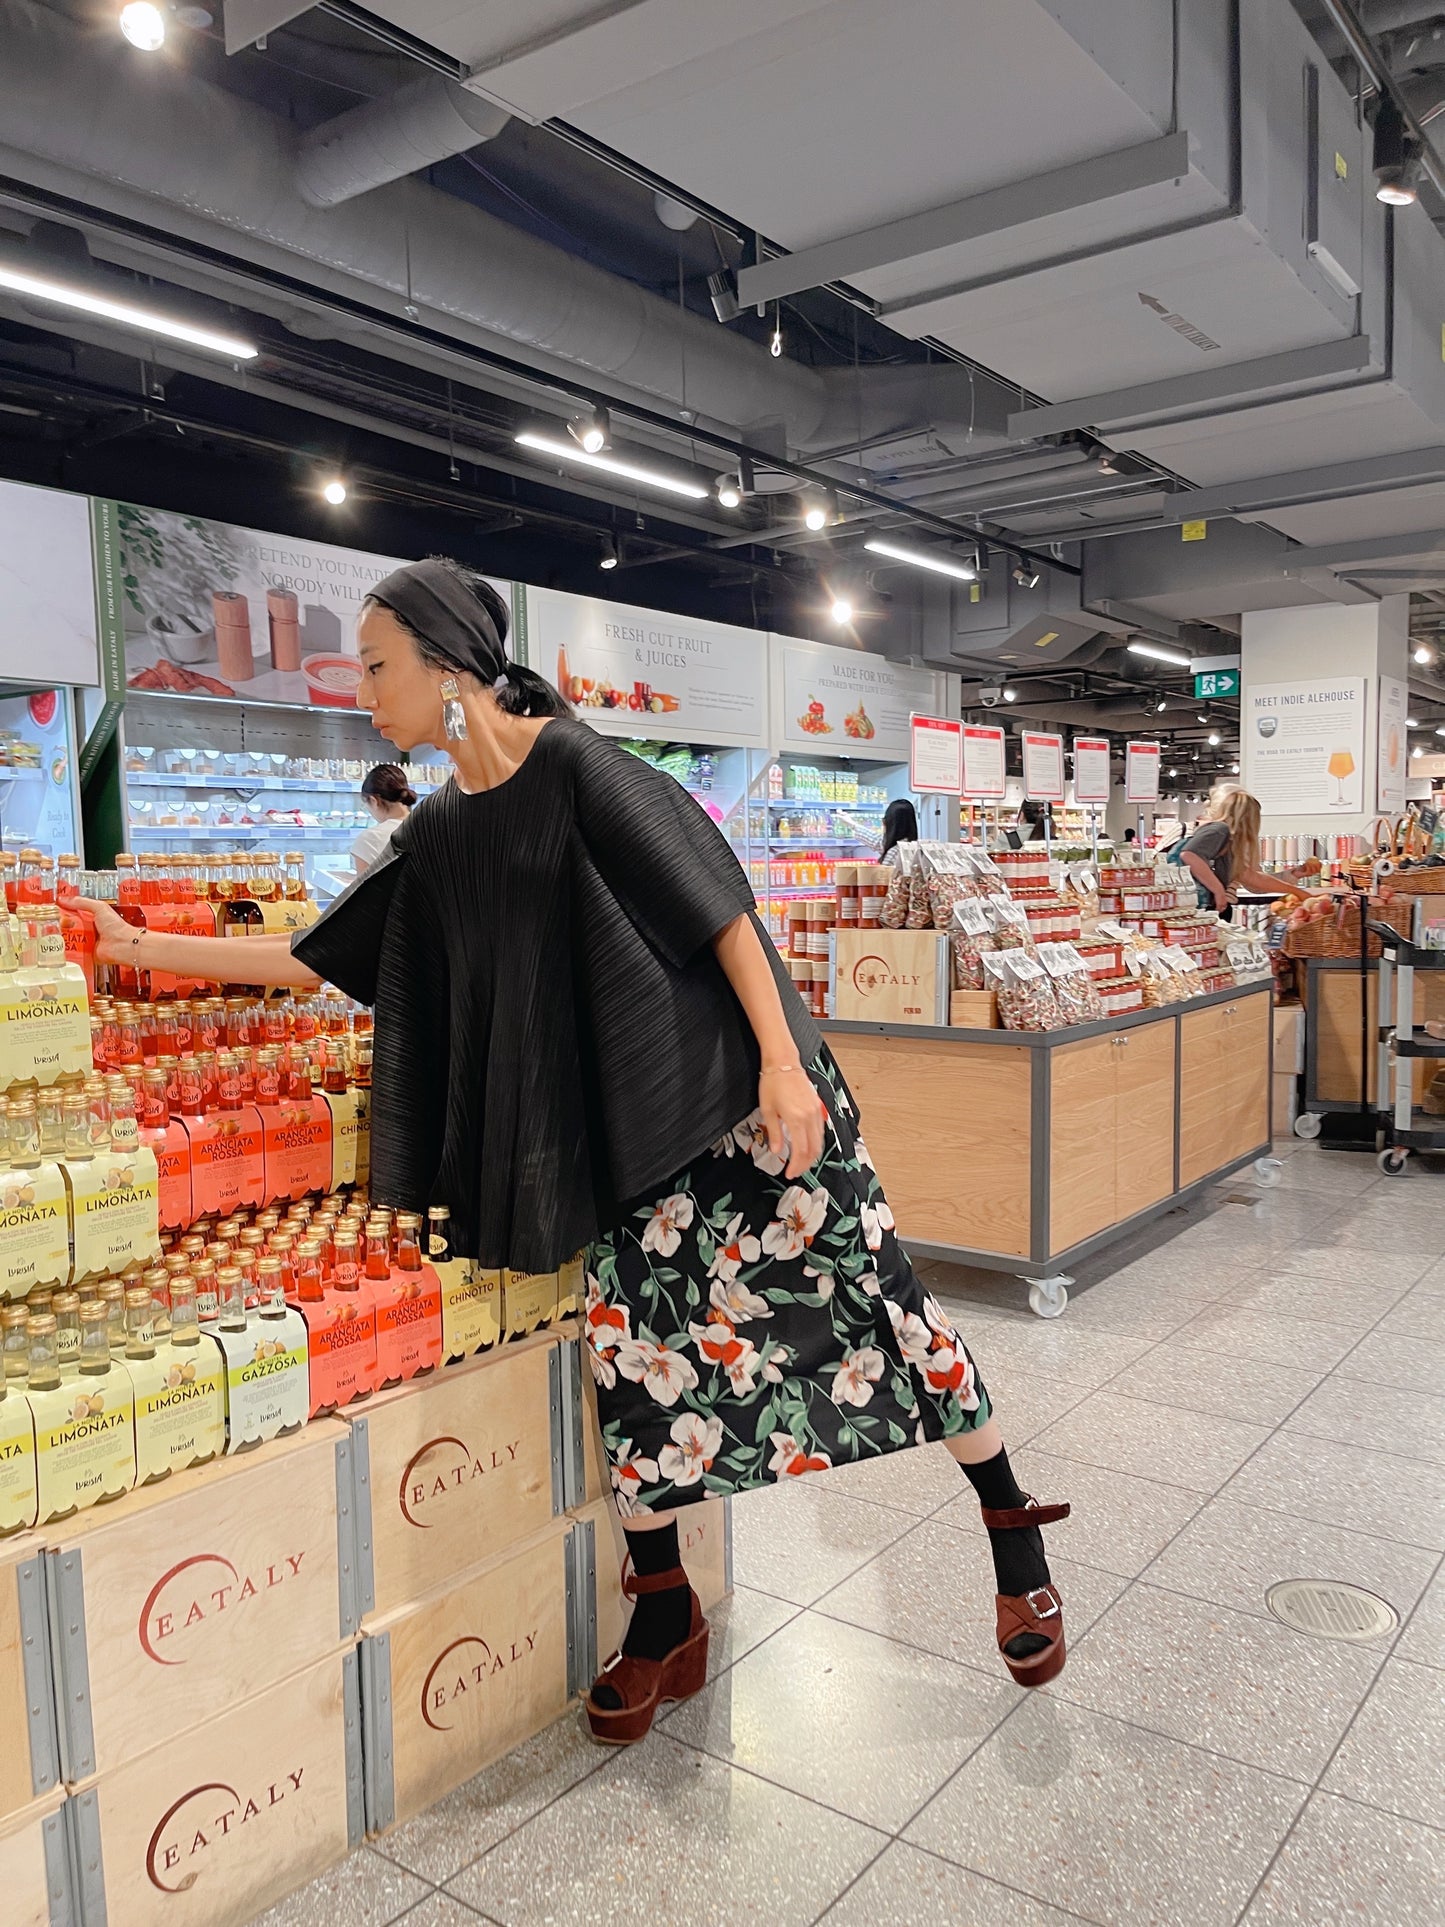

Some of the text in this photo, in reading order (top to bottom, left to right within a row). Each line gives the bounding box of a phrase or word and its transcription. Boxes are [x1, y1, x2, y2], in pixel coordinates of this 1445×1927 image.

[104, 543, 112, 579] KITCHEN
[315, 556, 348, 575] YOU
[260, 571, 327, 595] NOBODY
[604, 623, 712, 654] FRESH CUT FRUIT
[635, 648, 687, 668] & JUICES
[833, 664, 858, 679] MADE
[859, 669, 876, 682] FOR
[1254, 690, 1355, 708] MEET INDIE ALEHOUSE
[858, 973, 921, 986] EATALY
[7, 1003, 80, 1021] LIMONATA
[274, 1126, 323, 1143] ARANCIATA
[340, 1122, 371, 1136] CHINO
[200, 1137, 254, 1156] ARANCIATA
[284, 1137, 314, 1149] ROSSA
[212, 1148, 244, 1162] ROSSA
[86, 1189, 152, 1212] LIMONATA
[0, 1206, 57, 1228] MONATA
[449, 1282, 495, 1306] CHINOTTO
[386, 1299, 434, 1321] ARANCIATA
[395, 1312, 425, 1327] ROSSA
[319, 1321, 370, 1345] ARANCIATA
[330, 1334, 362, 1351] ROSSA
[242, 1356, 298, 1382] GAZZOSA
[148, 1382, 216, 1413] LIMONATA
[50, 1413, 125, 1448] LIMONATA
[412, 1440, 520, 1506] EATALY
[155, 1552, 305, 1641] EATALY
[434, 1629, 538, 1710] EATALY
[163, 1768, 304, 1872] EATALY
